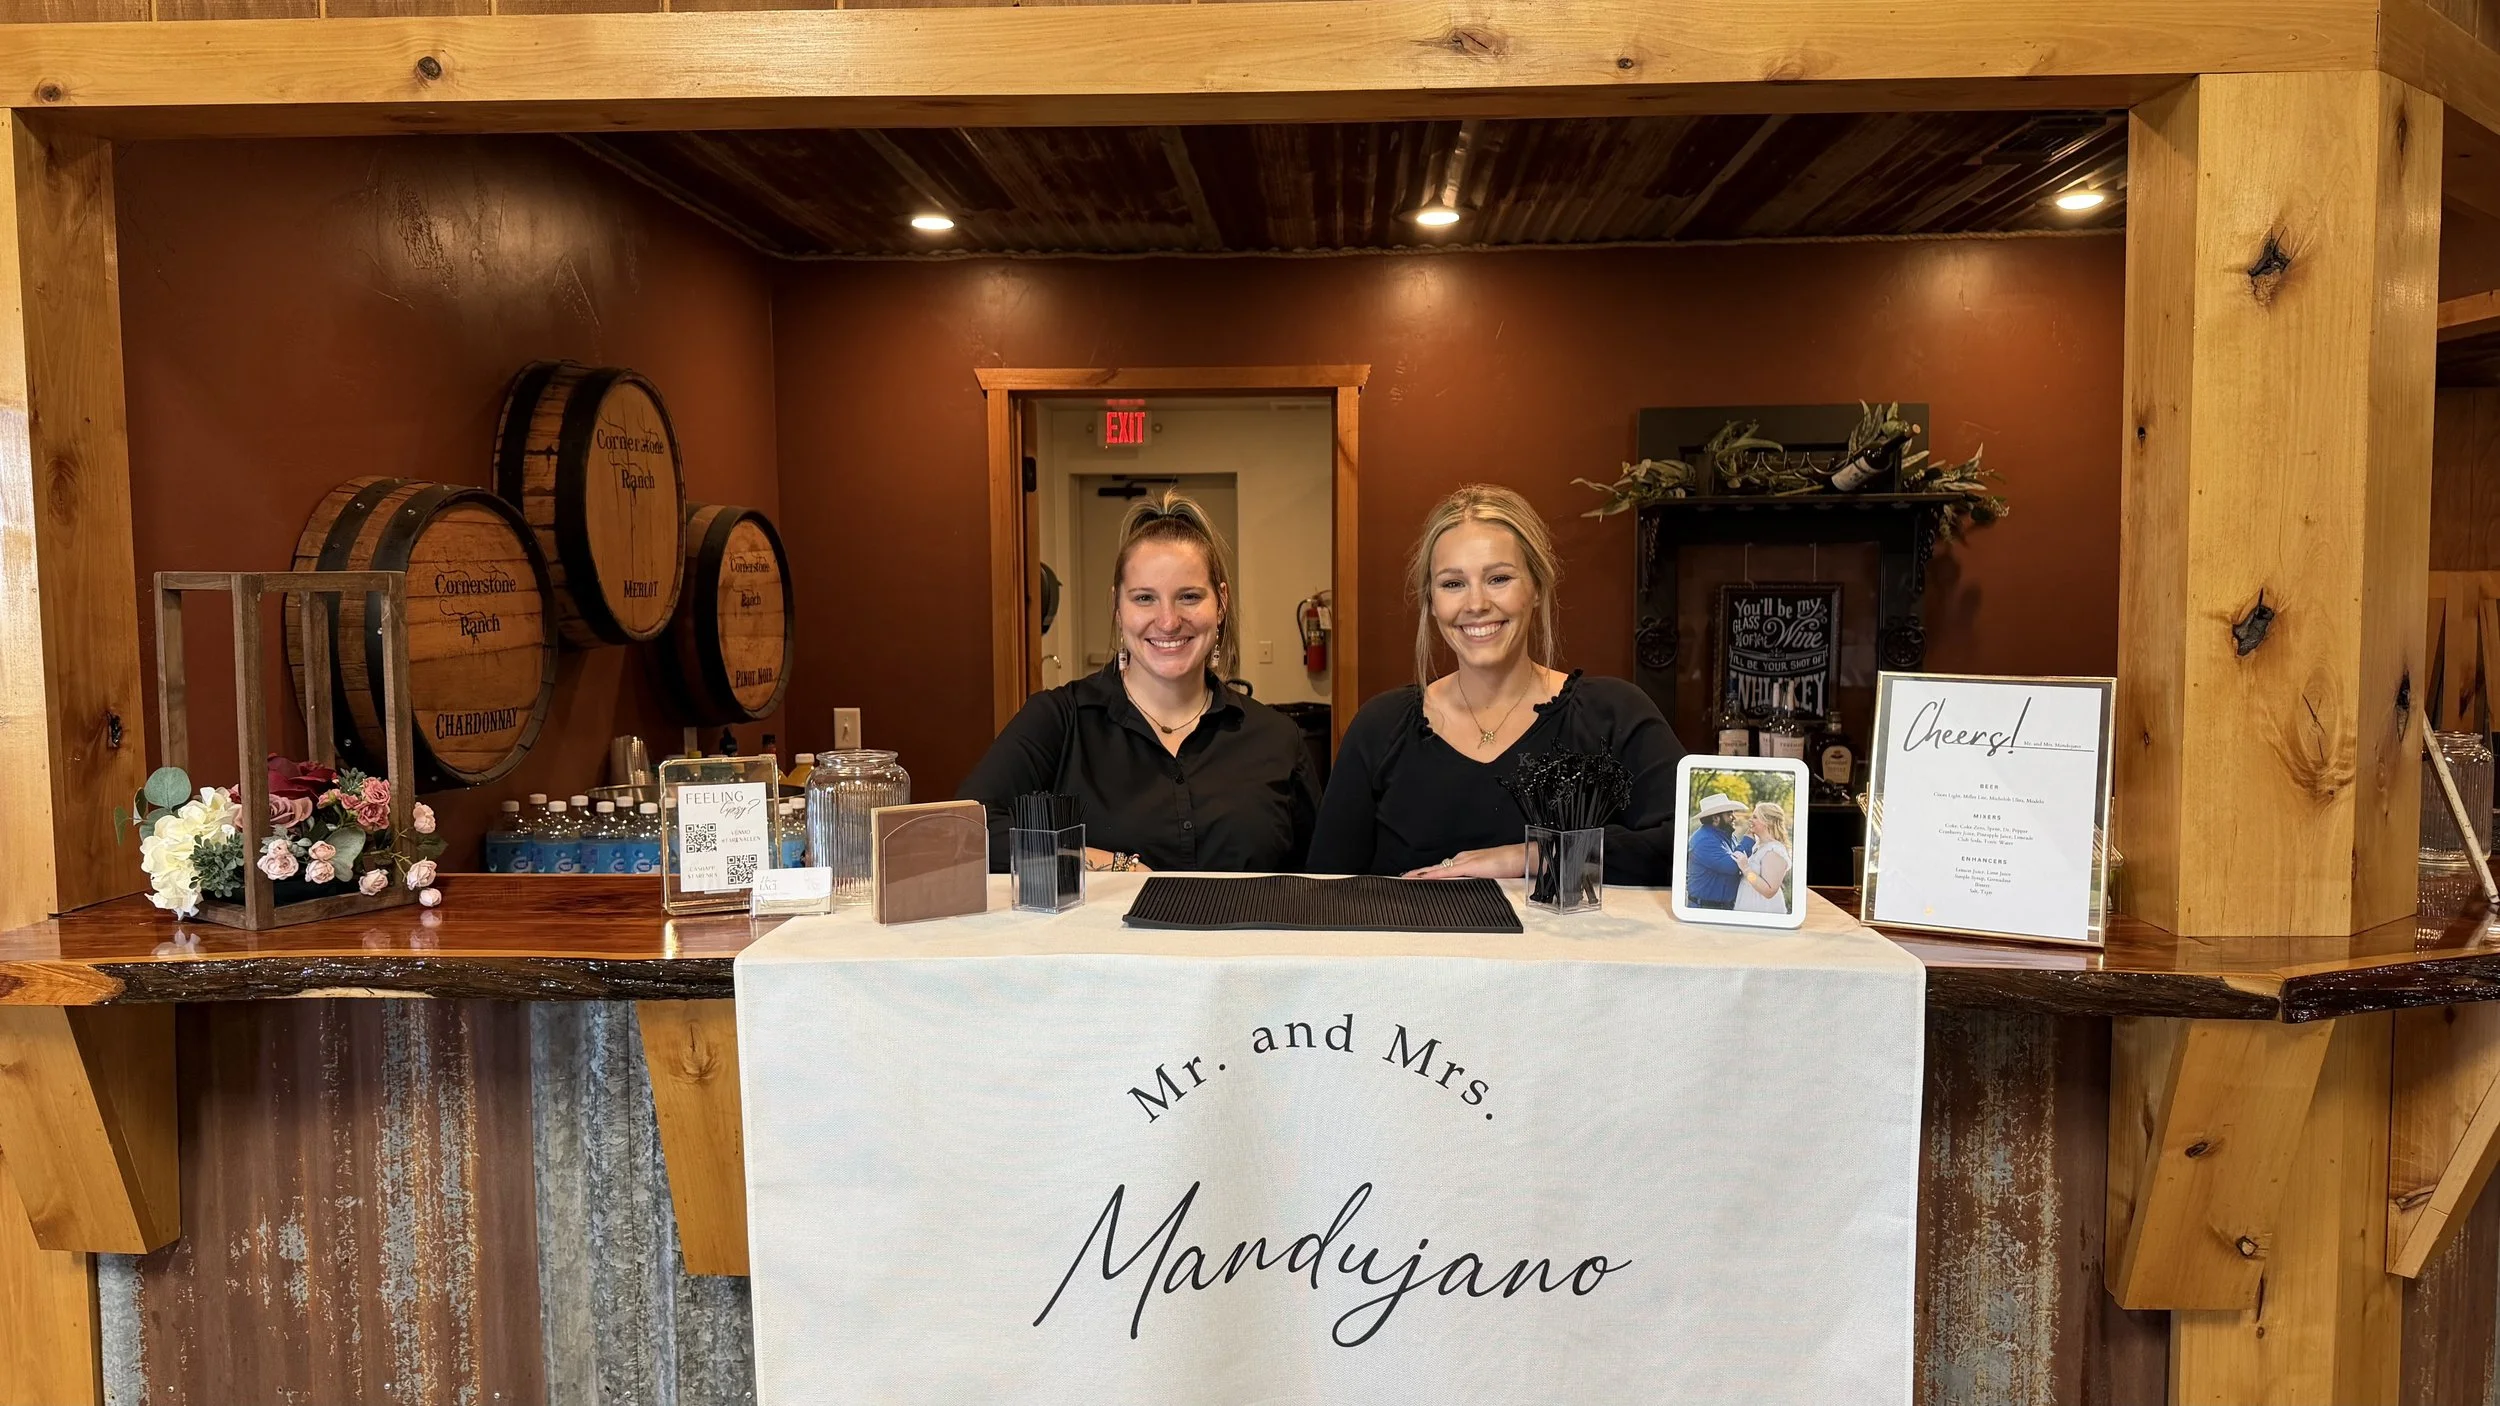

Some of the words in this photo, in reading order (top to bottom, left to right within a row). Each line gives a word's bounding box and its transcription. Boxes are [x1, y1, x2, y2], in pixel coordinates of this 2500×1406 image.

[1106, 411, 1146, 444] EXIT
[596, 428, 664, 455] Cornerstone
[621, 468, 655, 489] Ranch
[434, 572, 517, 595] Cornerstone
[623, 579, 659, 598] MERLOT
[1734, 597, 1773, 618] You'll
[1777, 597, 1793, 619] be
[1796, 597, 1822, 620] my
[460, 613, 501, 637] Ranch
[1732, 615, 1760, 634] GLASS
[1762, 616, 1823, 649] Wine
[1742, 633, 1754, 647] OF
[1746, 659, 1759, 670] BE
[1762, 661, 1788, 672] YOUR
[1790, 657, 1810, 670] SHOT
[1812, 654, 1822, 666] OF
[735, 669, 757, 689] PINOT
[757, 667, 773, 685] NOIR
[435, 706, 518, 740] CHARDONNAY
[1903, 696, 2032, 757] Cheers!
[685, 790, 744, 805] FEELING
[1973, 813, 2001, 821] MIXERS
[1961, 855, 2007, 865] ENHANCERS
[1127, 1055, 1227, 1124] Mr.
[1251, 1013, 1355, 1054] and
[1382, 1024, 1494, 1121] Mrs.
[1033, 1181, 1632, 1347] Mandujano
